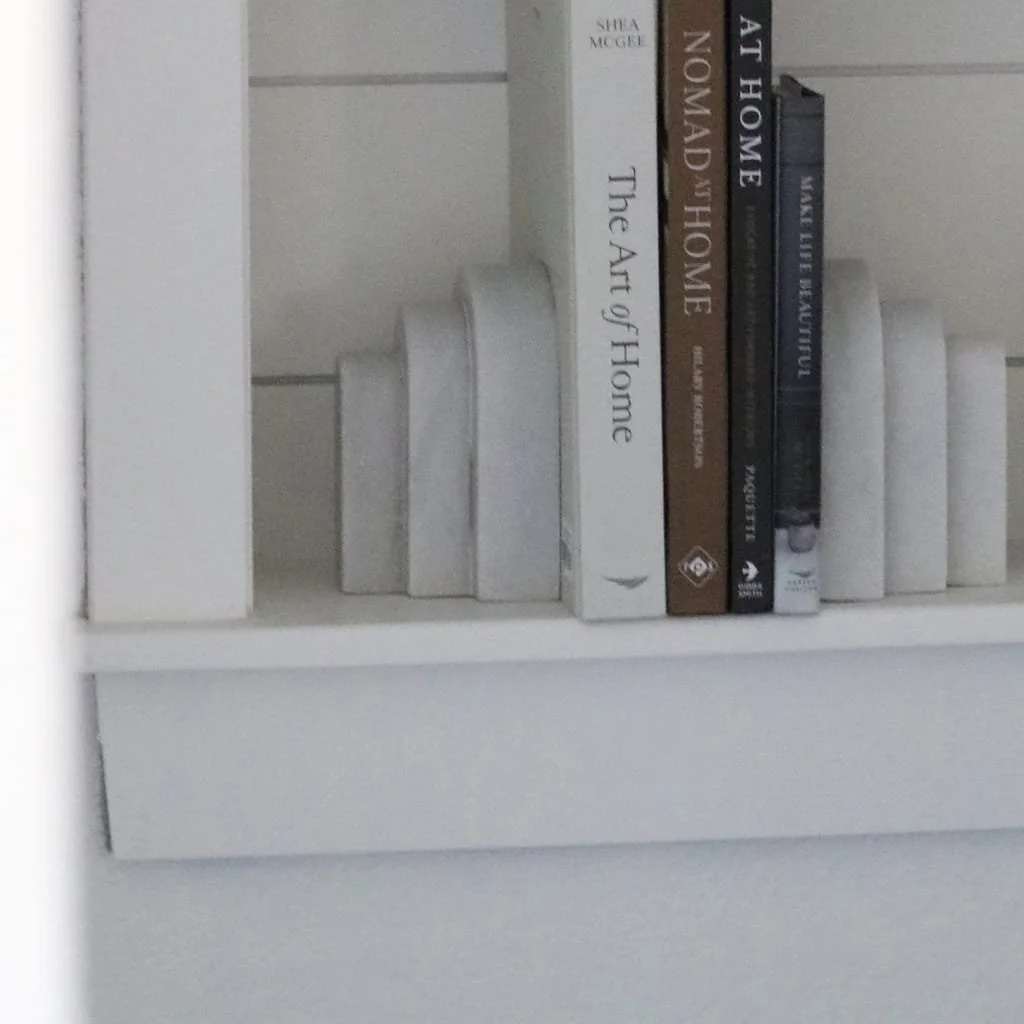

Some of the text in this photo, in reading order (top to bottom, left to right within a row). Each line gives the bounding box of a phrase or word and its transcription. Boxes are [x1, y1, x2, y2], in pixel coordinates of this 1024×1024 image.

[595, 18, 640, 32] SHEA
[739, 14, 763, 62] AT
[683, 30, 713, 316] NOMAD AT HOME
[739, 77, 763, 188] HOME
[601, 165, 640, 444] The Art of Home
[797, 175, 814, 379] MAKE LIFE BEAUTIFUL
[743, 464, 757, 544] PAQUETTE
